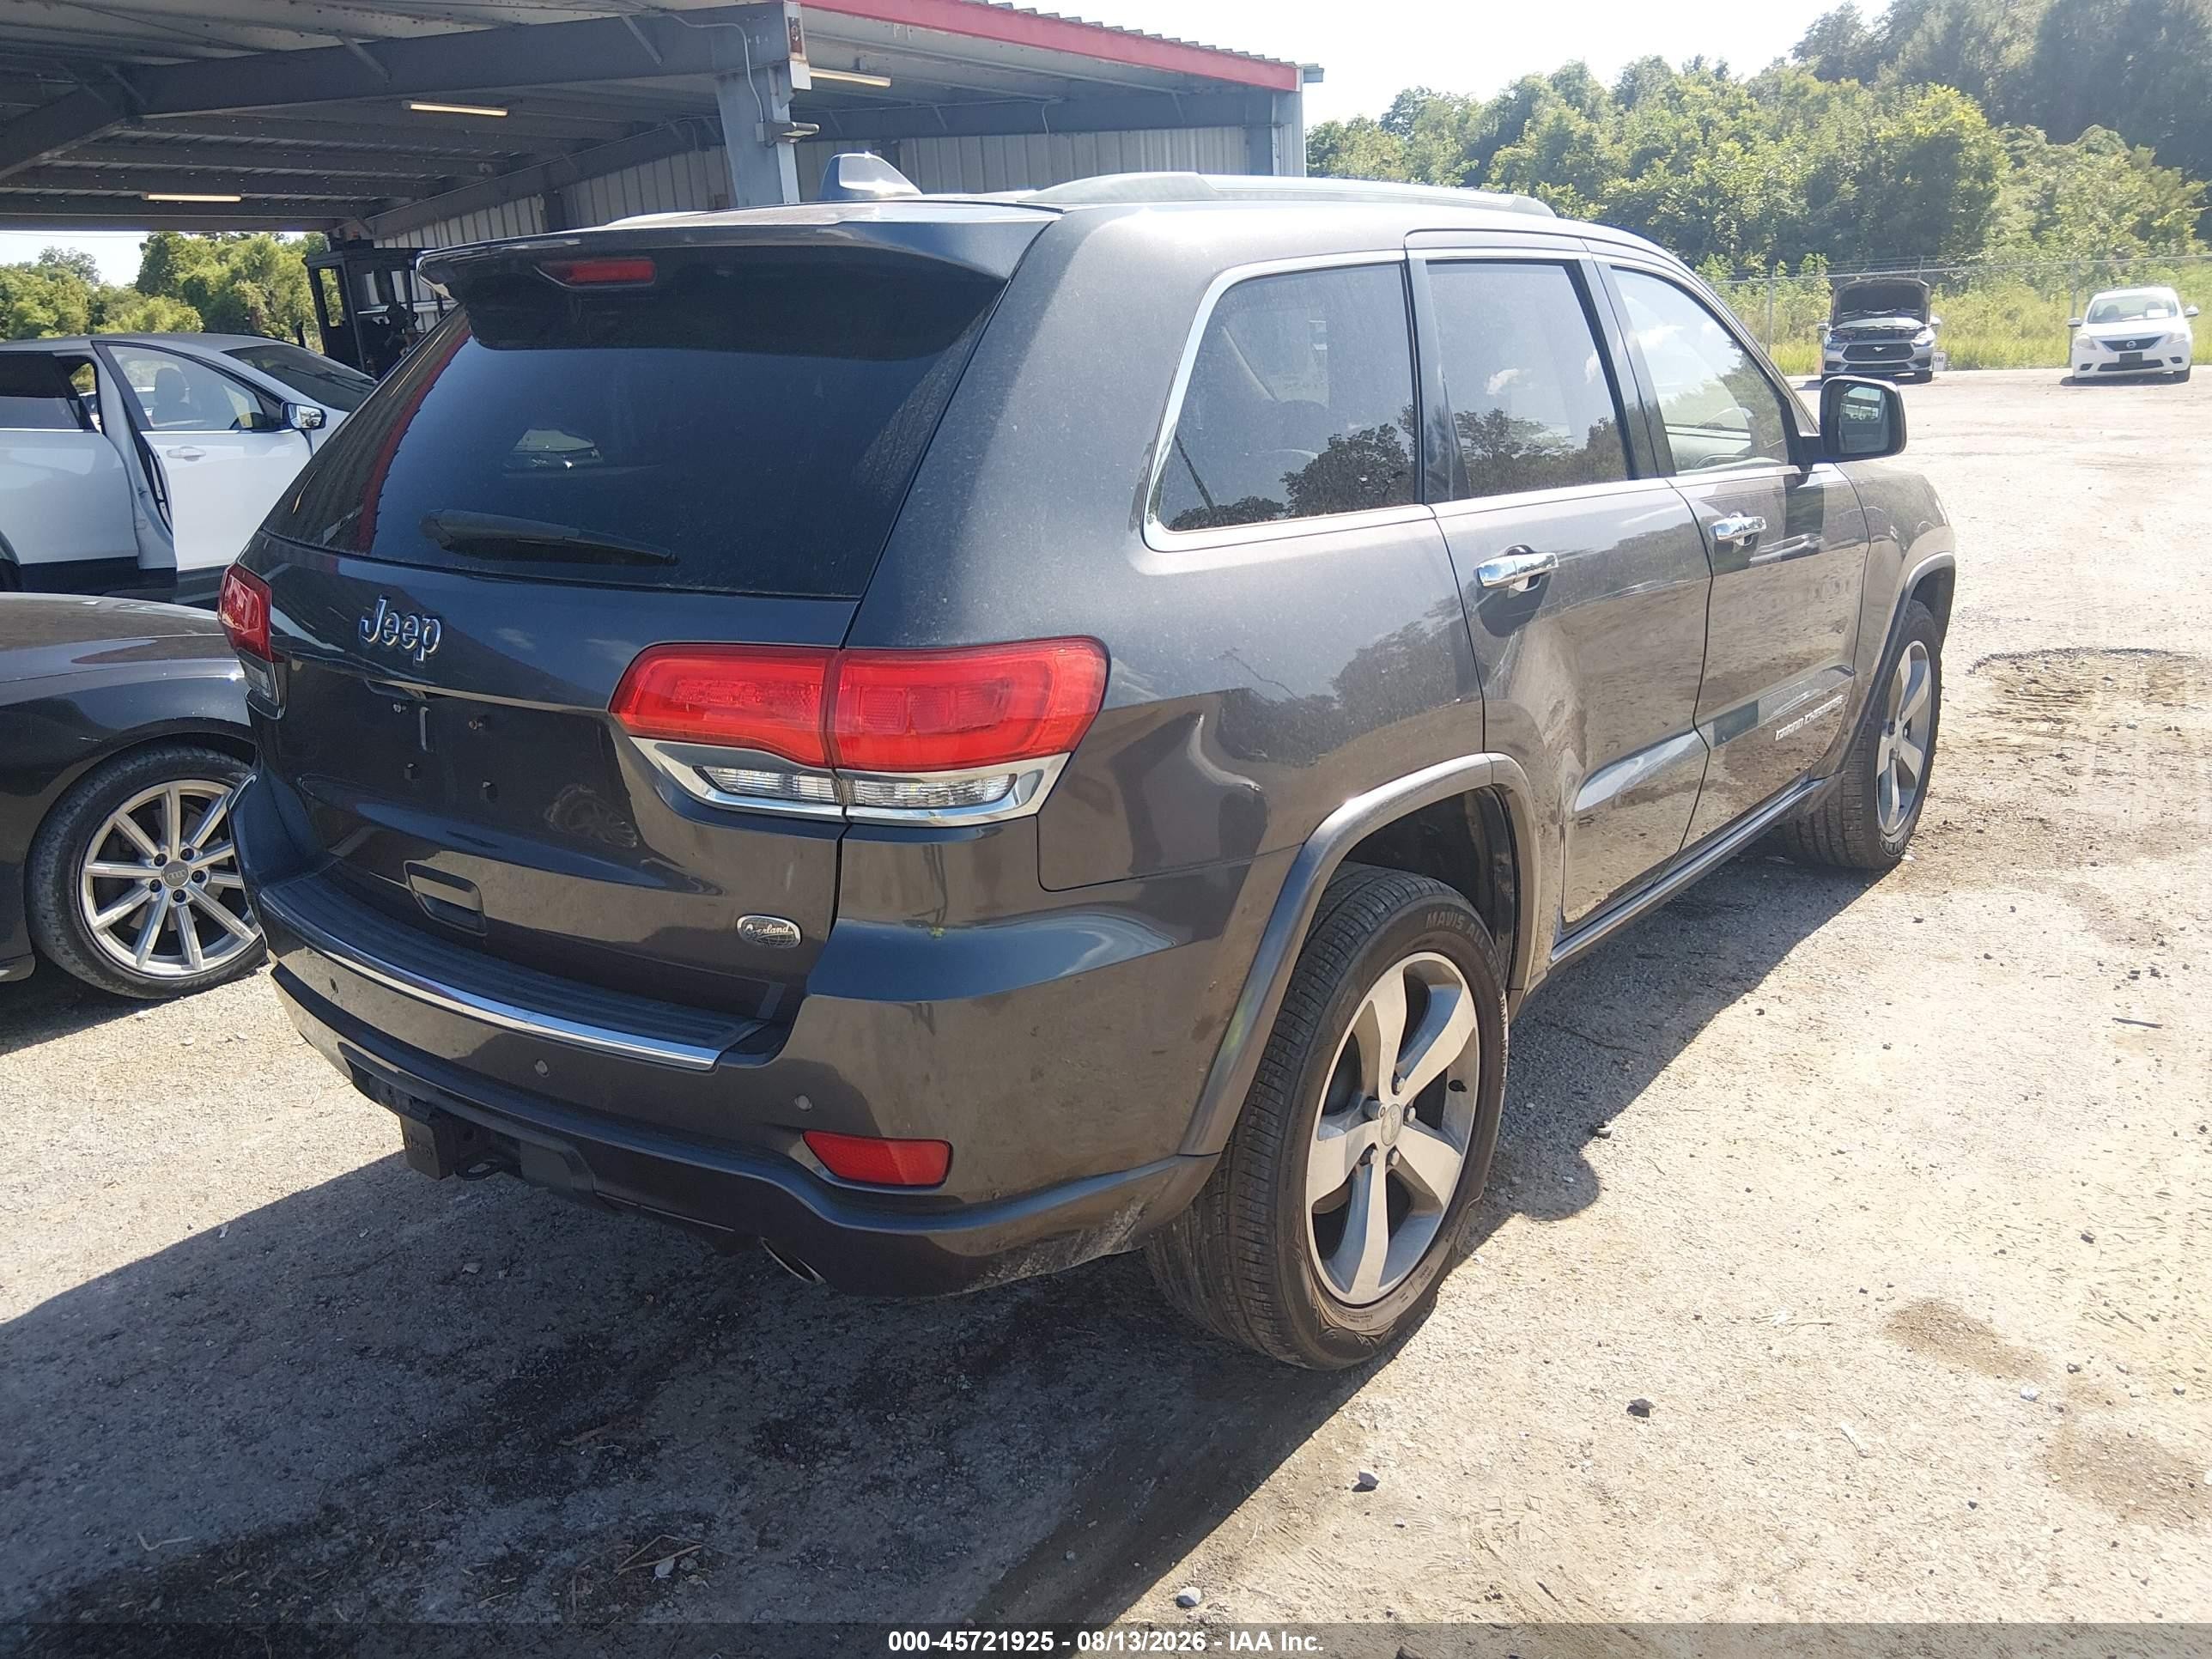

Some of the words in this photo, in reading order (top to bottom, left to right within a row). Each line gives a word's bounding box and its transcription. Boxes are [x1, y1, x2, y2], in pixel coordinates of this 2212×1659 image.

[358, 594, 442, 665] Jeep
[744, 923, 793, 937] Overland
[1425, 910, 1465, 931] MAVIS
[1466, 922, 1486, 950] ALL
